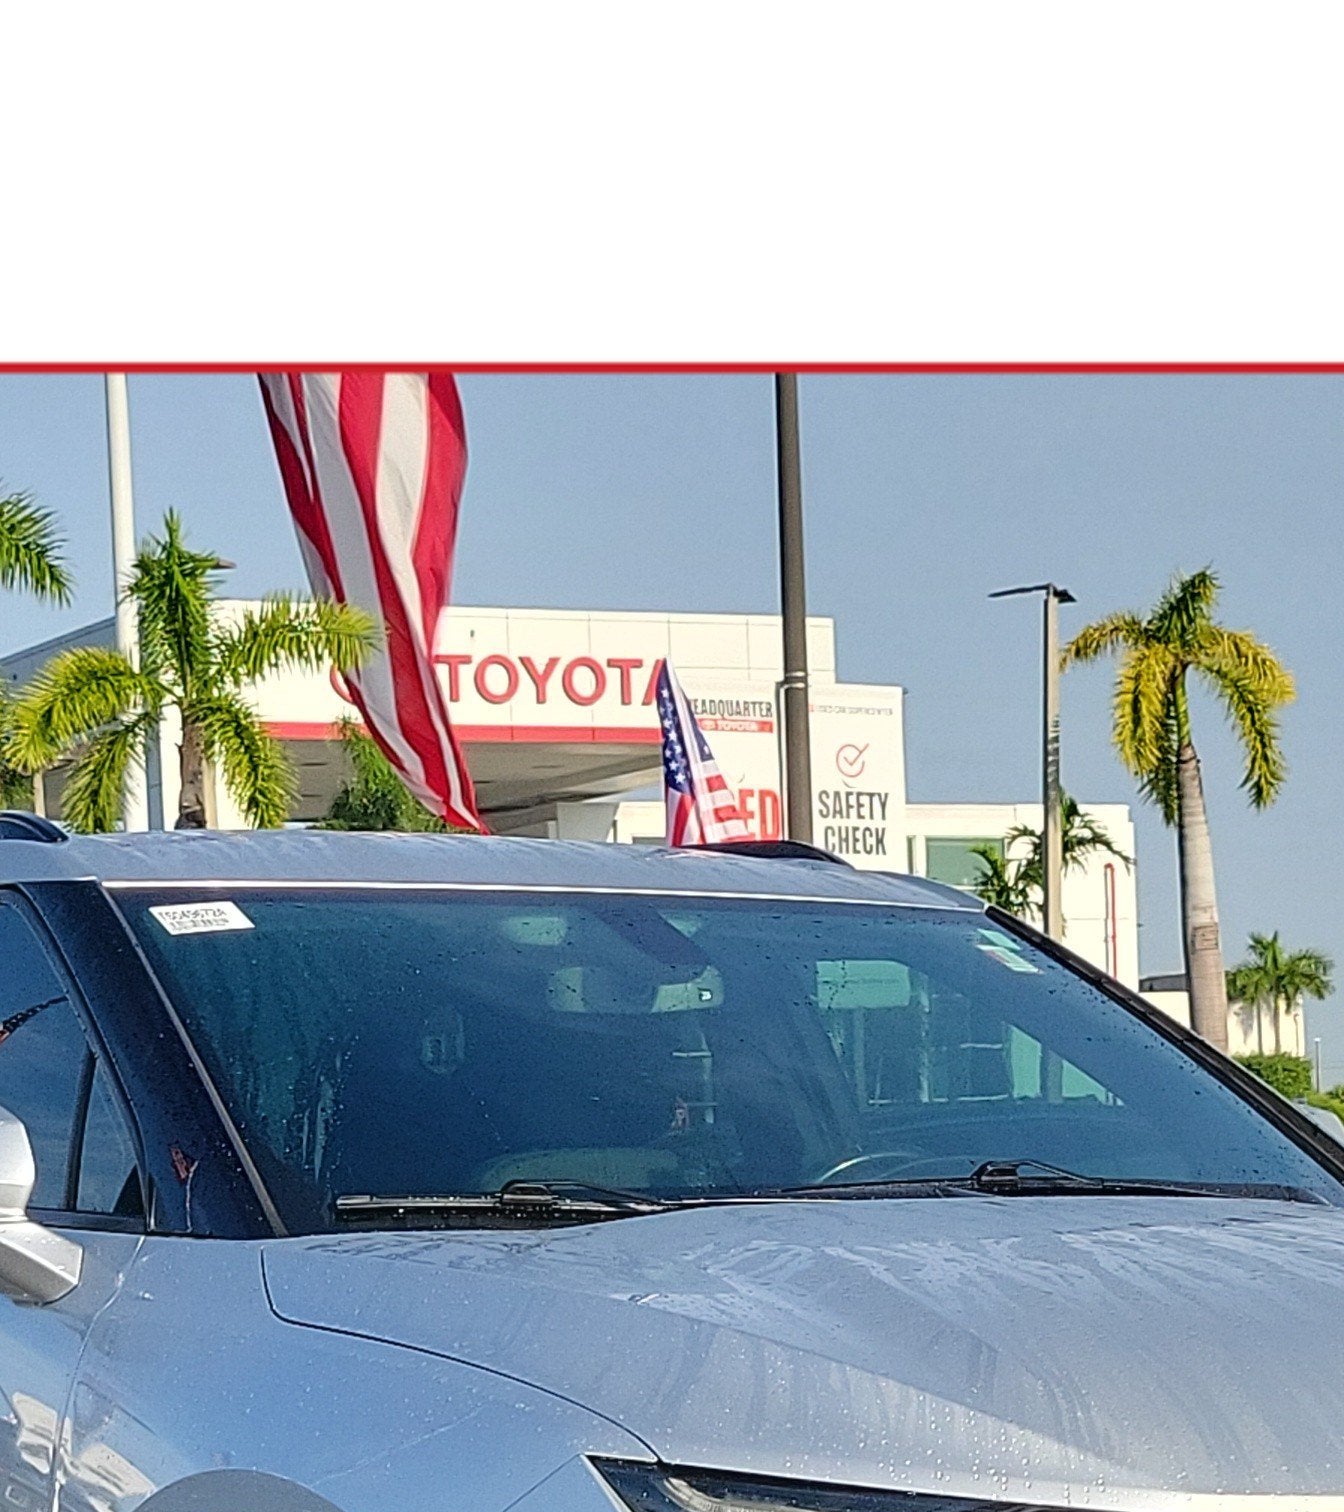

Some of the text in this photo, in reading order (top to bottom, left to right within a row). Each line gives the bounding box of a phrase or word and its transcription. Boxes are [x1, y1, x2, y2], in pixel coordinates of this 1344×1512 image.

[692, 699, 773, 719] EADQUARTER
[739, 789, 783, 841] ED
[818, 789, 890, 821] SAFETY
[824, 825, 888, 857] CHECK
